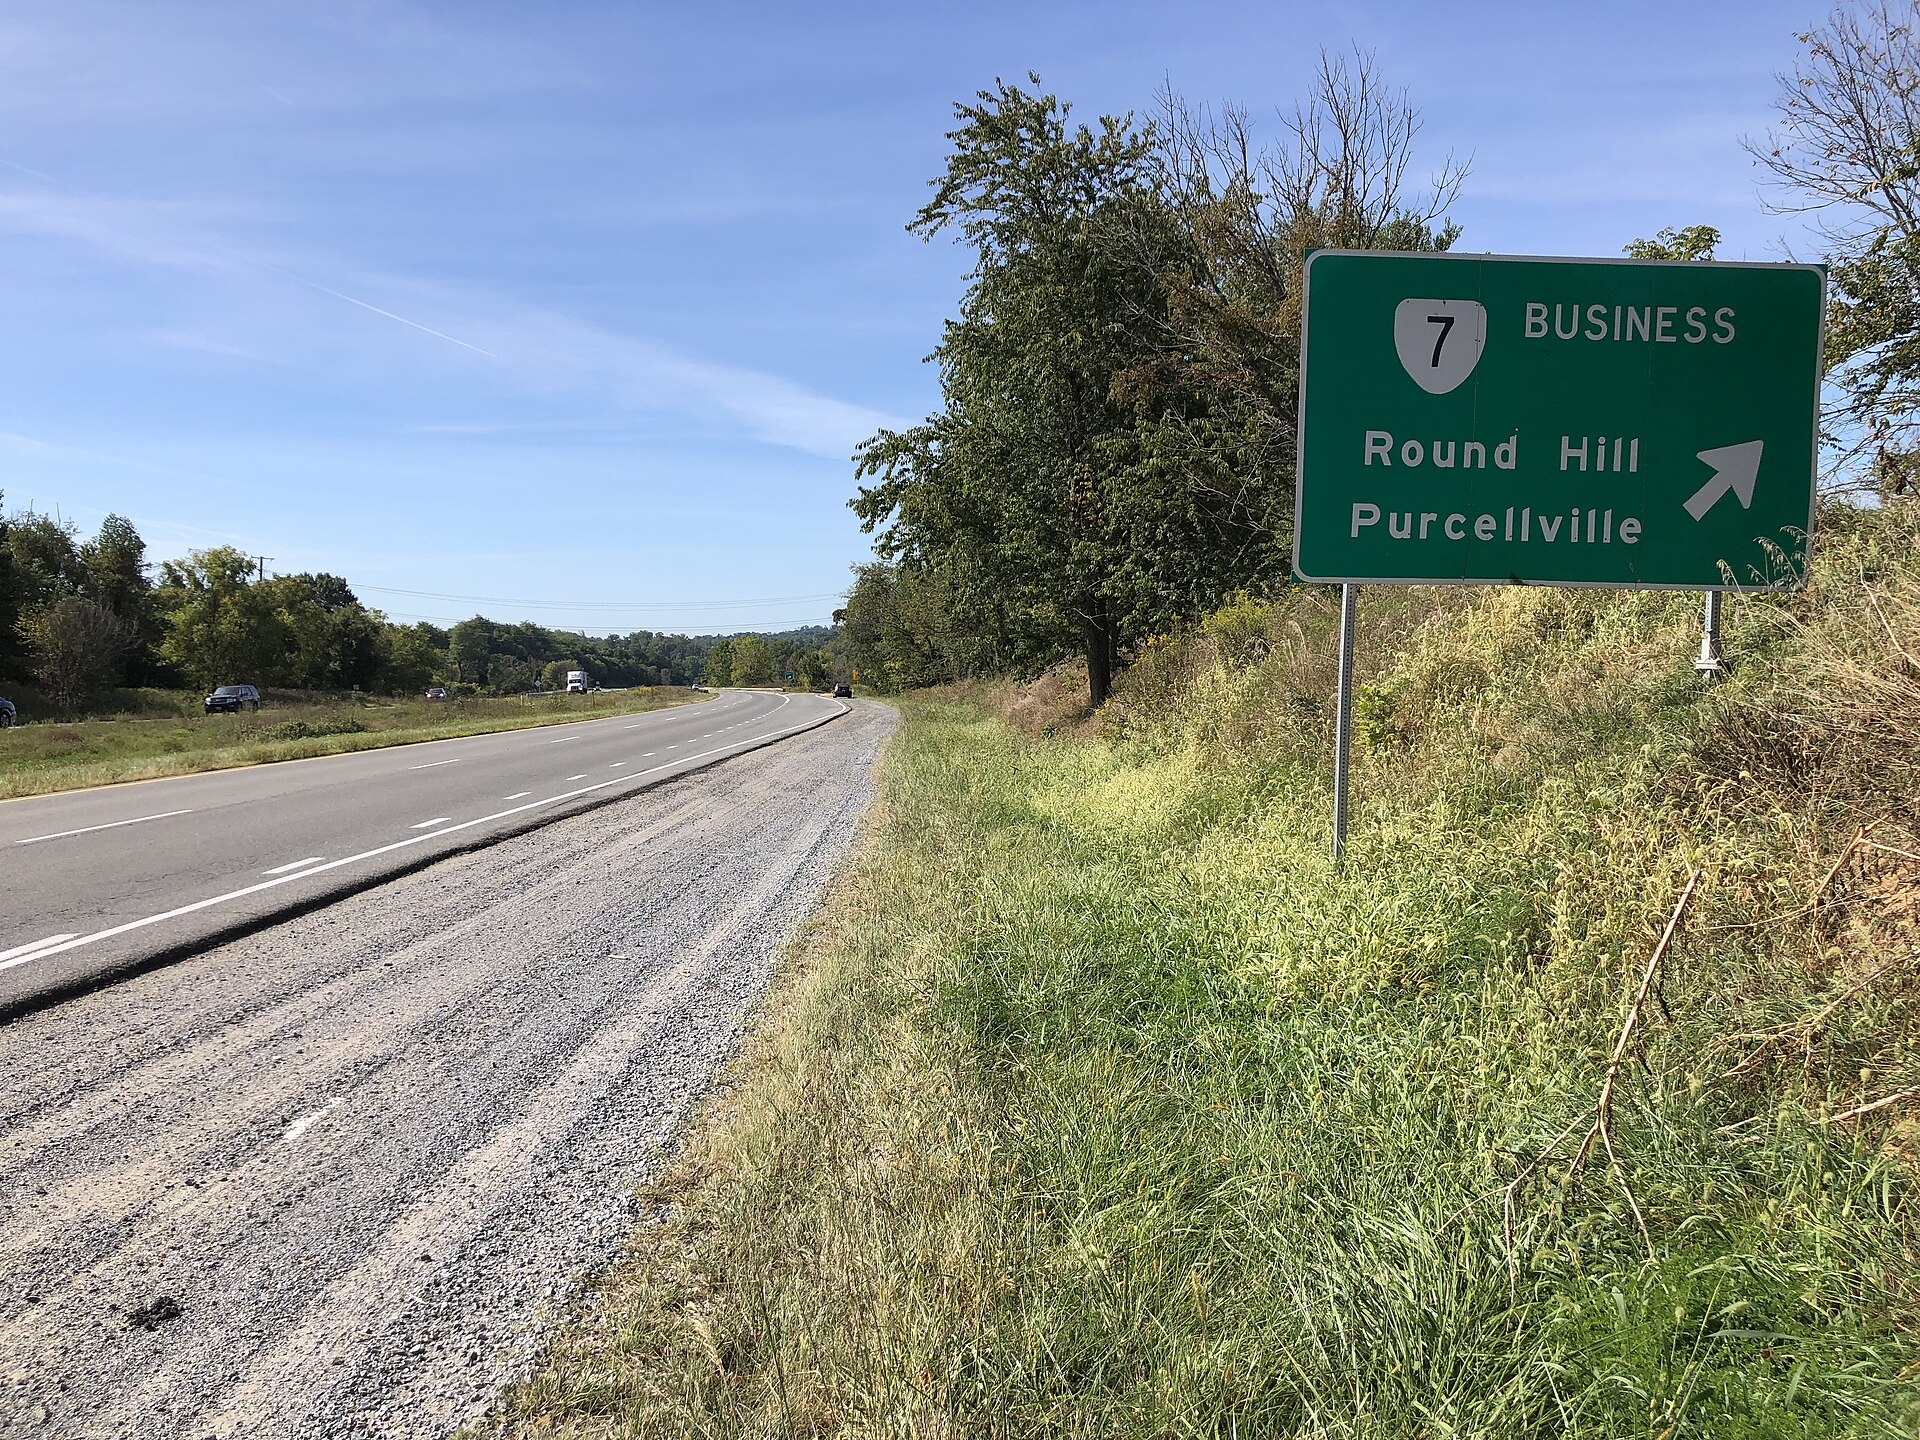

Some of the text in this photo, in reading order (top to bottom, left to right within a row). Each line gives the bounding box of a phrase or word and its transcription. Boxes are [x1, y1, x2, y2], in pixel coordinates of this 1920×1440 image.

[1427, 315, 1455, 368] 7
[1525, 302, 1736, 344] BUSINESS
[1364, 429, 1639, 473] Round Hill
[1351, 502, 1642, 544] Purcellville
